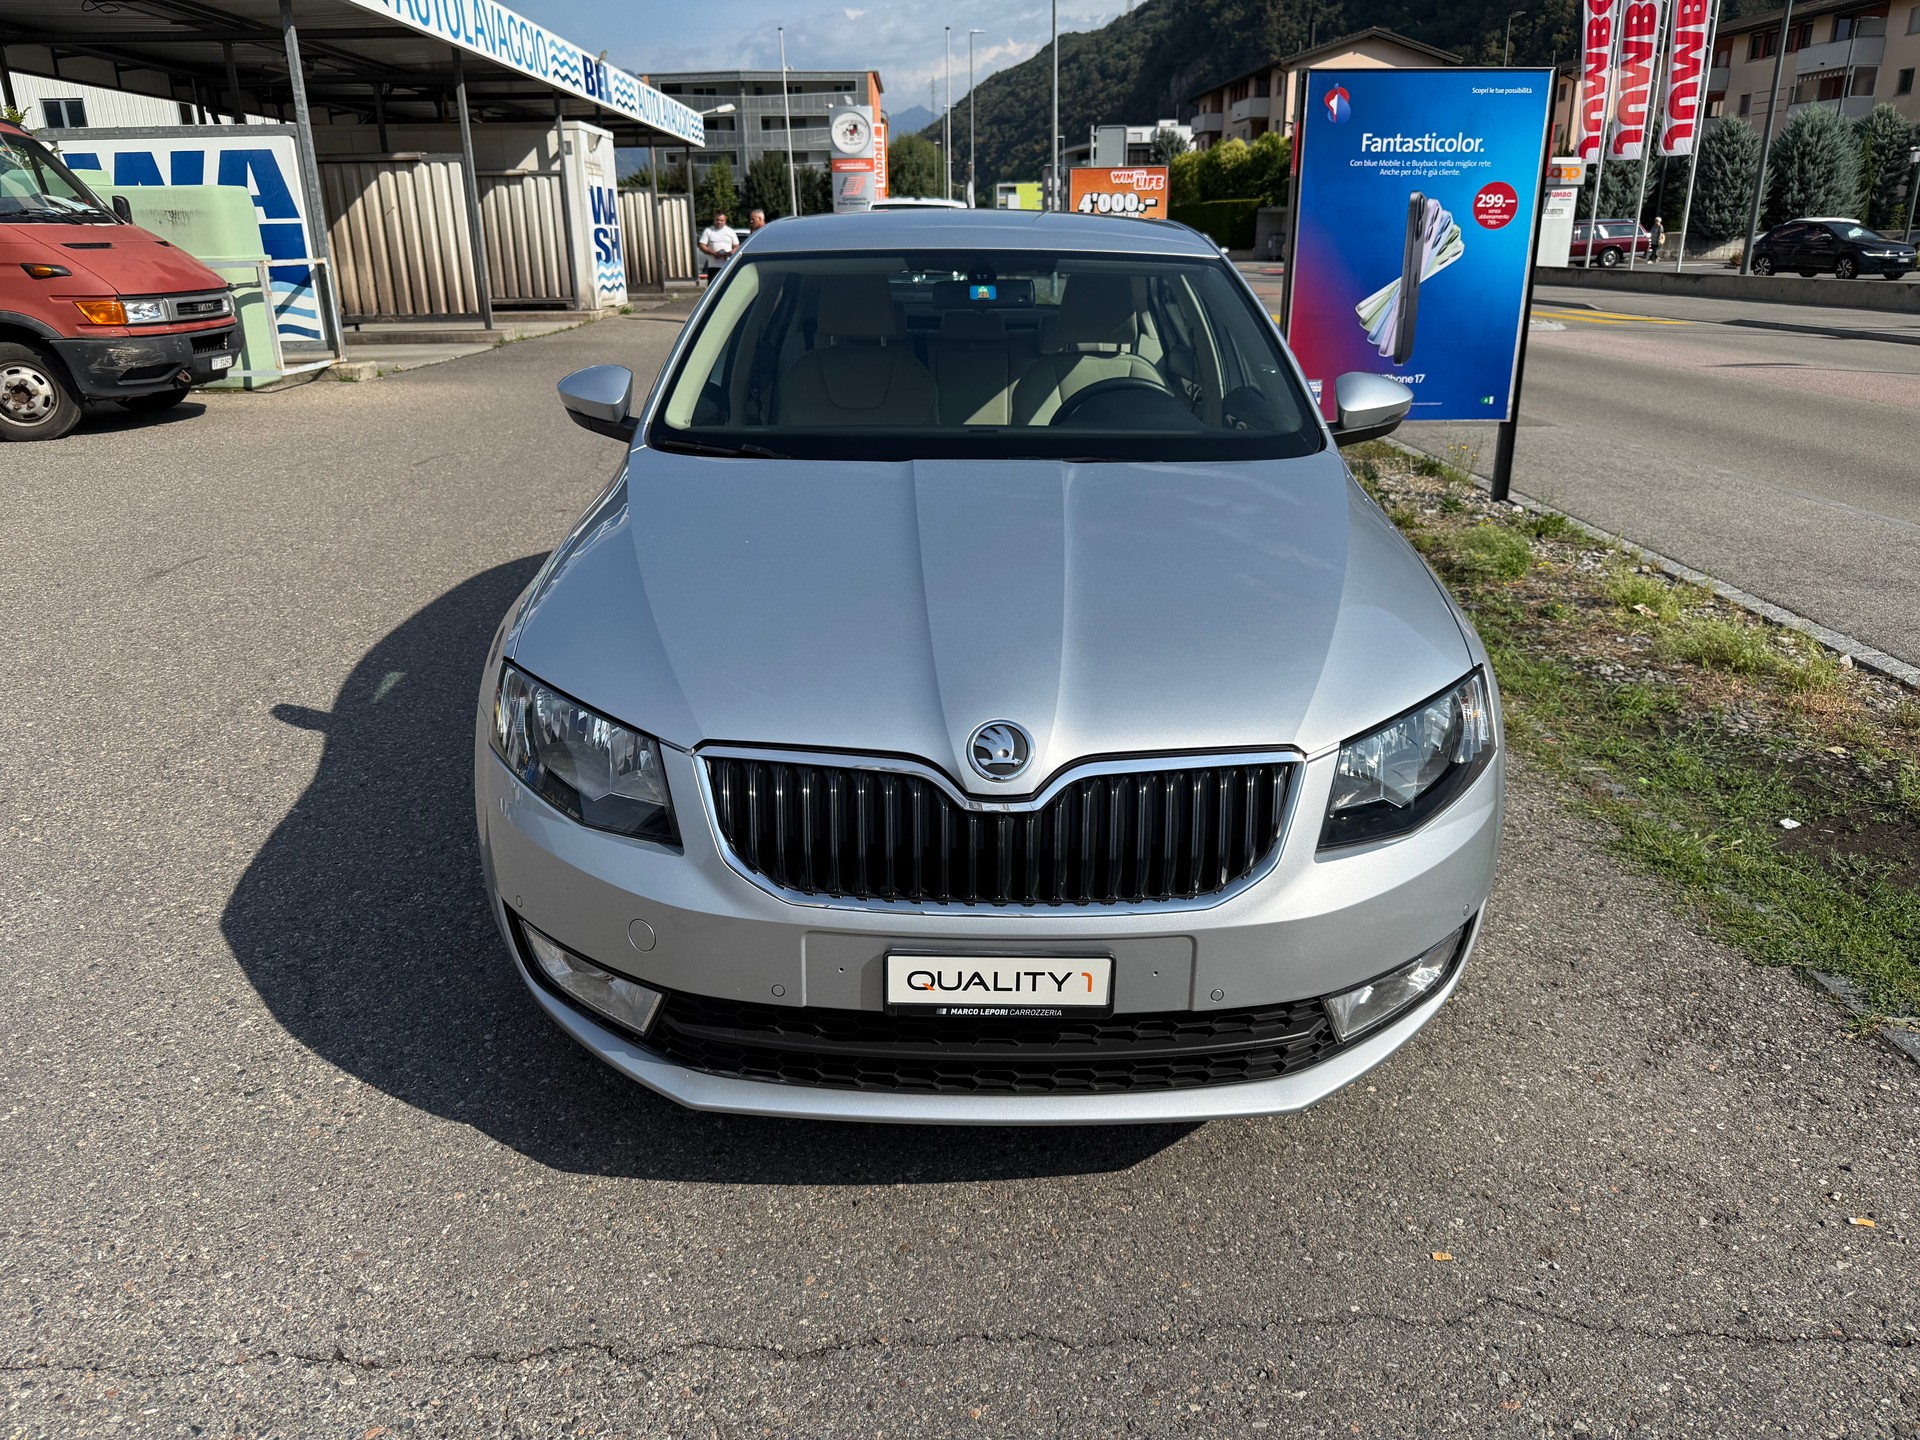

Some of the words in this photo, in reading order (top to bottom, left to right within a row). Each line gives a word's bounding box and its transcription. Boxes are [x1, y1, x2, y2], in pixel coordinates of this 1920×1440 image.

[396, 0, 548, 78] OLAVAGGIO
[582, 54, 612, 104] BEL
[1613, 0, 1657, 155] JUMB
[1472, 87, 1489, 95] Scopri
[1505, 87, 1533, 95] possibilità
[1361, 132, 1485, 153] Fantasticolor.
[1411, 160, 1438, 169] Buyback
[1455, 160, 1477, 169] miglior
[1112, 172, 1134, 183] WIN
[1379, 168, 1399, 176] Anche
[1412, 168, 1422, 176] chi
[1423, 168, 1427, 176] è
[1428, 168, 1438, 177] già
[1439, 168, 1461, 176] cliente.
[1546, 167, 1581, 181] oop
[1134, 177, 1163, 189] LIFE
[1381, 374, 1414, 384] hone
[907, 970, 1073, 992] QUALITY
[1081, 972, 1093, 993] 1
[950, 1008, 979, 1016] MARCO
[980, 1008, 1009, 1016] LEPORI
[1009, 1008, 1063, 1017] CARROZZERIA
